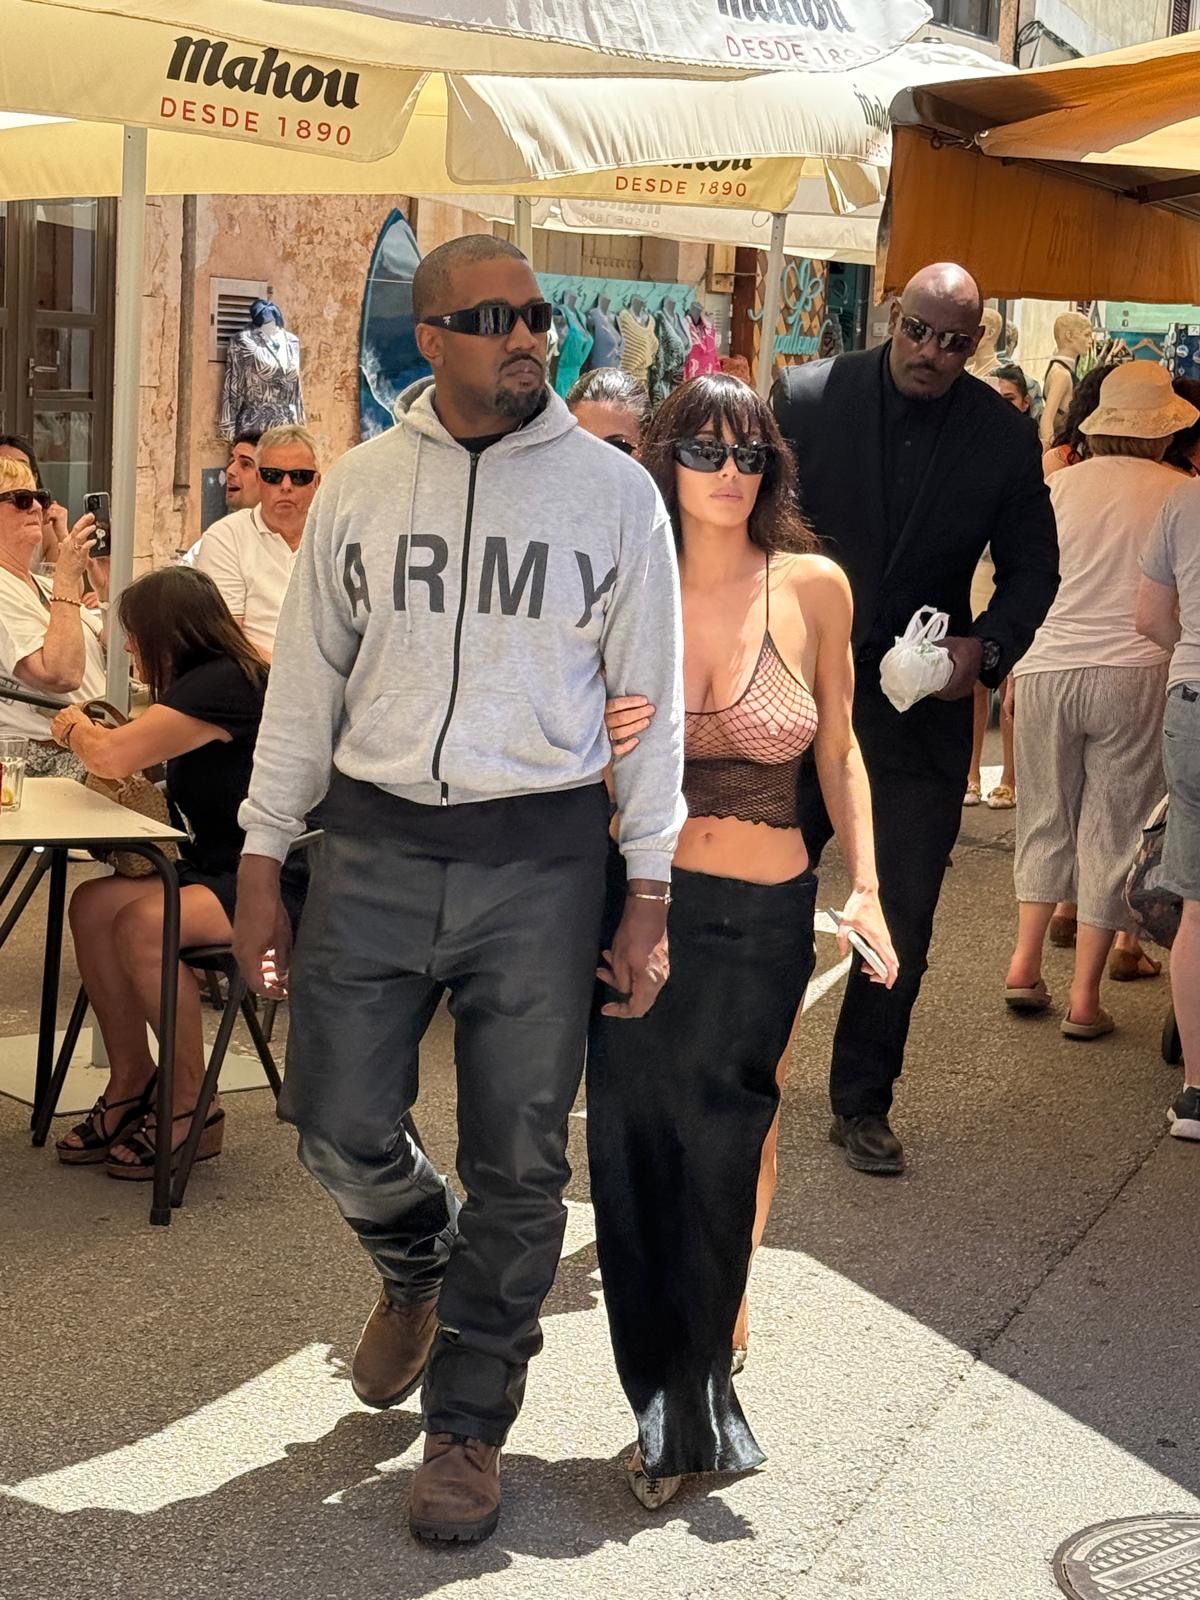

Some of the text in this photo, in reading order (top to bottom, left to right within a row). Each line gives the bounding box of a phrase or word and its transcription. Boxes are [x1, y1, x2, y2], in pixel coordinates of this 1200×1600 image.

[166, 35, 361, 110] Mahou
[726, 35, 809, 63] DESDE
[160, 96, 352, 146] DESDE 1890
[615, 175, 748, 198] DESDE 1890
[343, 532, 617, 629] ARMY
